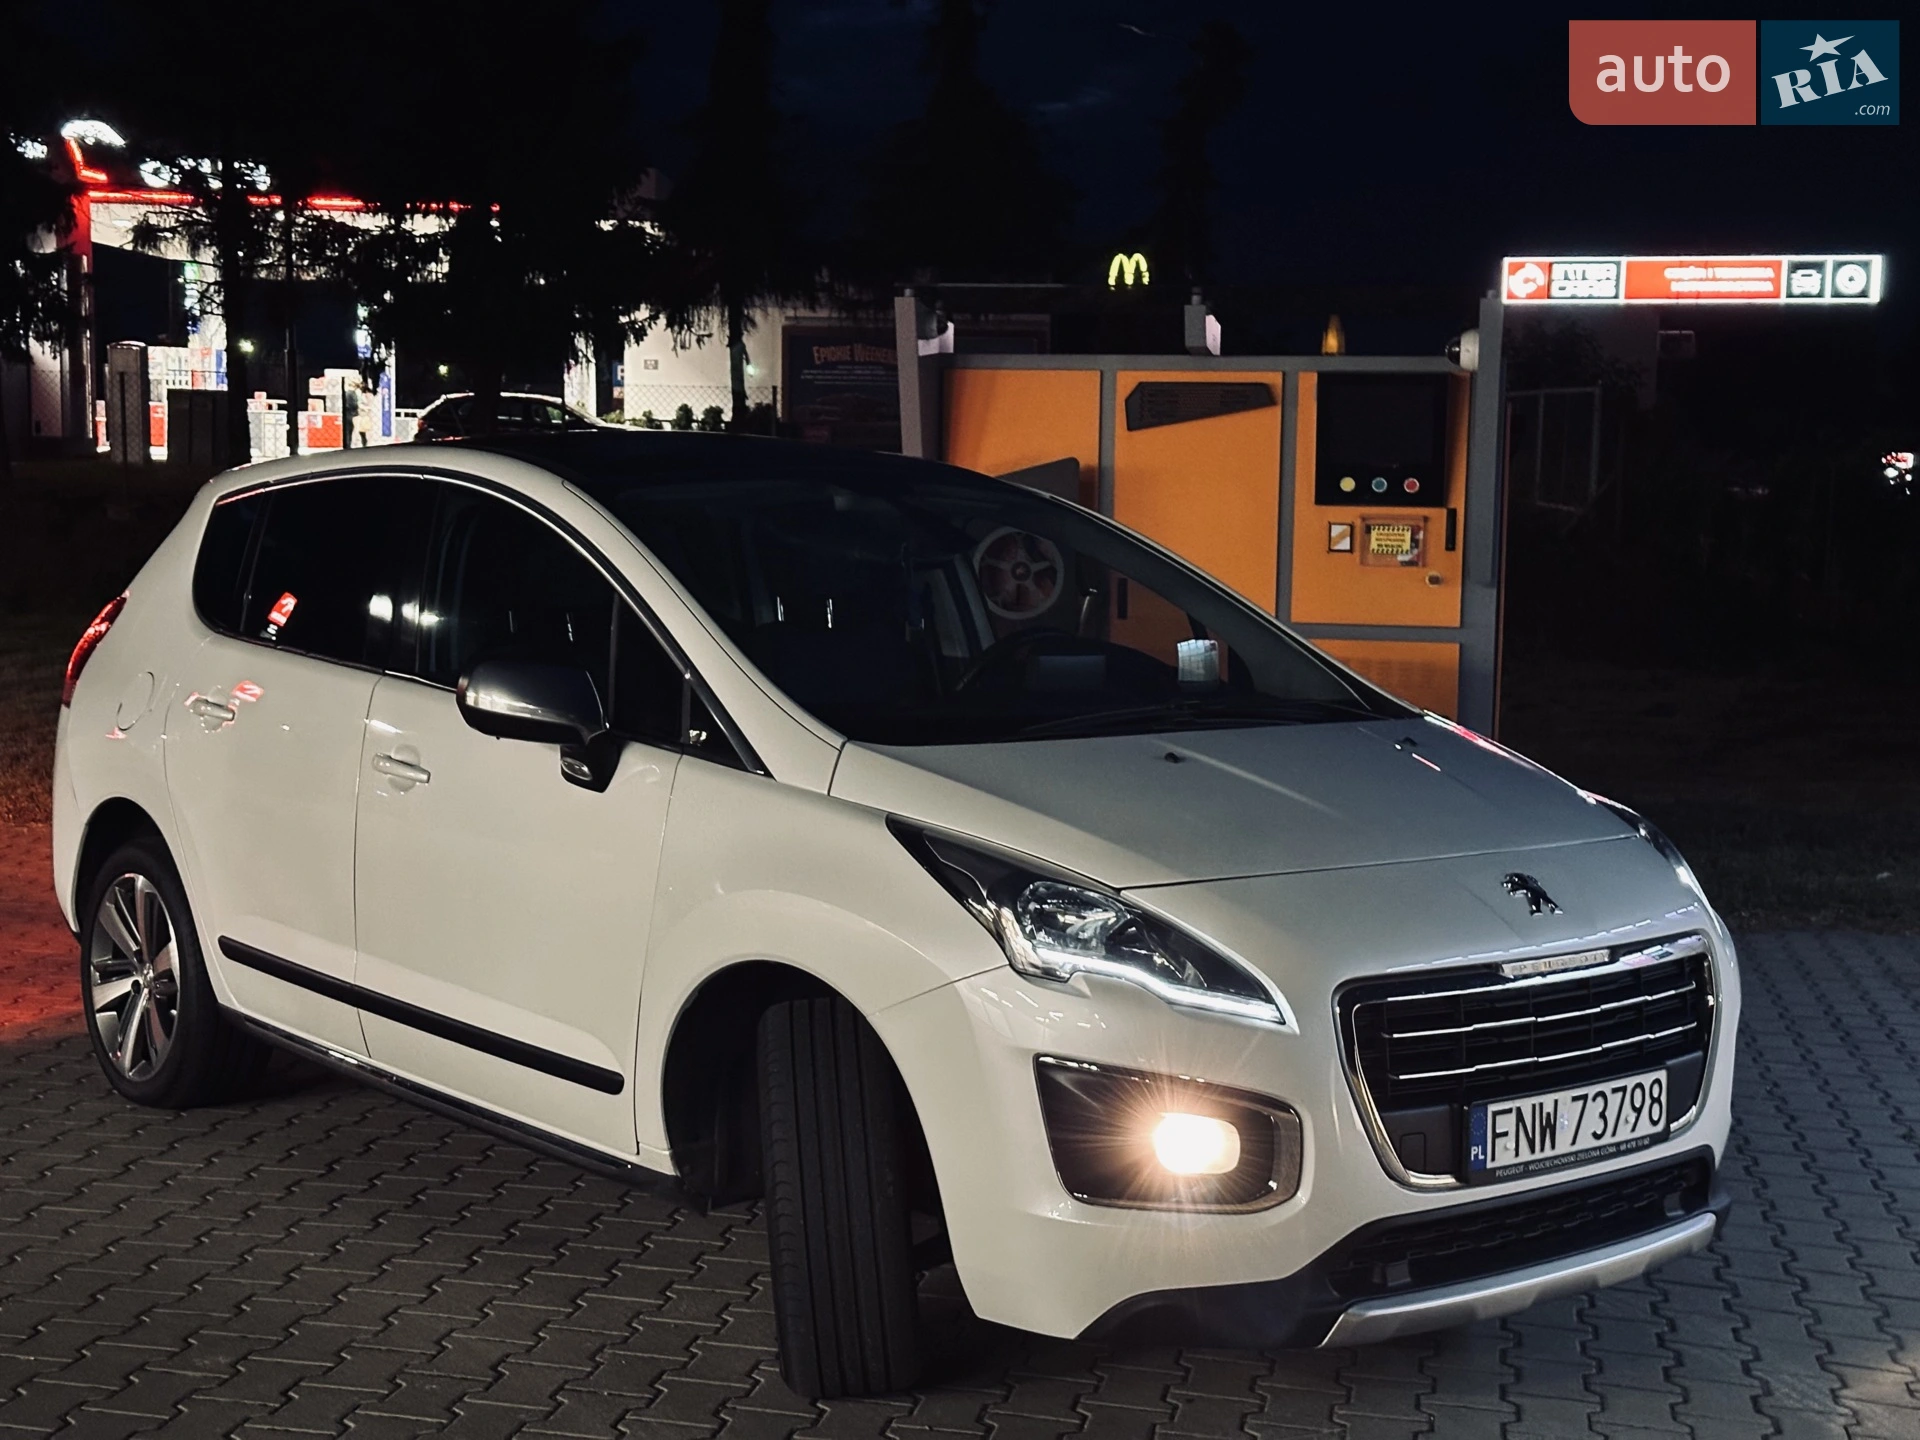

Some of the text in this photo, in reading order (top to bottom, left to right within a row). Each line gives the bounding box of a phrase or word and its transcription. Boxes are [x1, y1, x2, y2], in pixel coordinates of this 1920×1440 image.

[1490, 1077, 1663, 1162] FNW 73798
[1471, 1145, 1485, 1160] PL
[1495, 1164, 1524, 1178] PEUGEOT
[1577, 1149, 1600, 1161] ZIELONA
